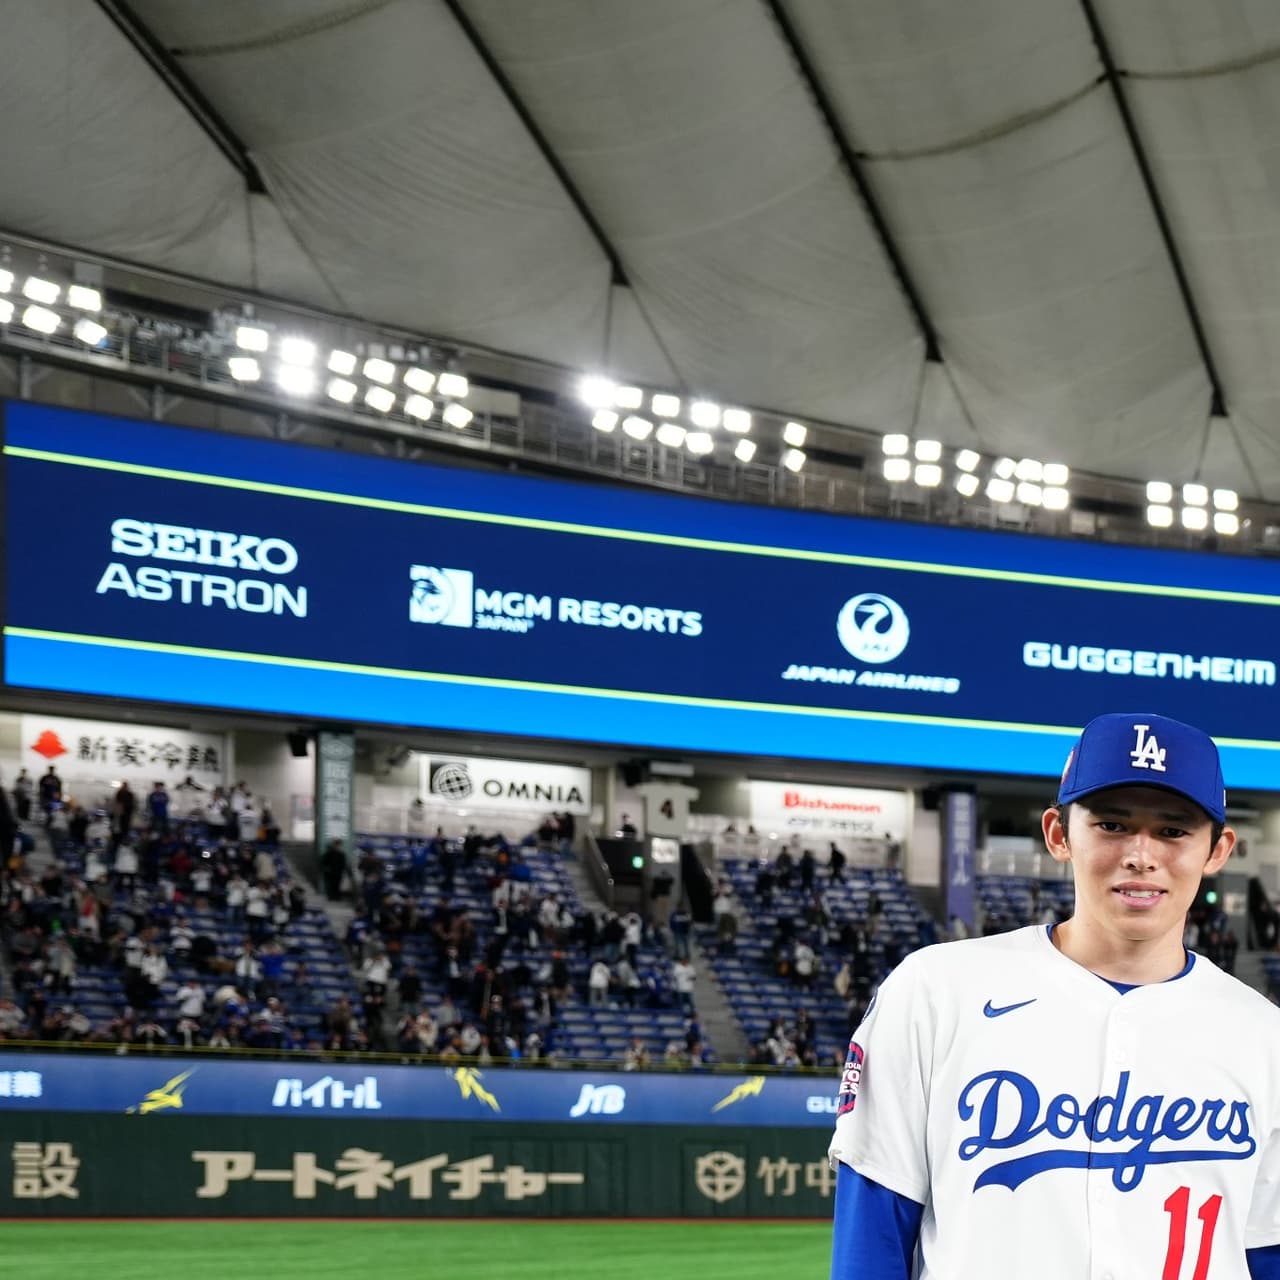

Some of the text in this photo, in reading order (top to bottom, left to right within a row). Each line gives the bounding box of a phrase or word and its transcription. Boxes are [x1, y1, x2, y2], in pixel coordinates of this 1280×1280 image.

[111, 518, 298, 574] SEIKO
[96, 562, 307, 617] ASTRON
[475, 588, 703, 636] MGM RESORTS
[782, 664, 961, 694] JAPAN AIRLINES
[1023, 641, 1276, 685] GUGGENHEIM
[1130, 724, 1166, 772] LA
[483, 778, 584, 805] OMNIA
[783, 791, 881, 812] Bishamon
[958, 1070, 1257, 1193] Dodgers
[12, 1142, 79, 1199] 設
[192, 1147, 584, 1200] アートネイチャー
